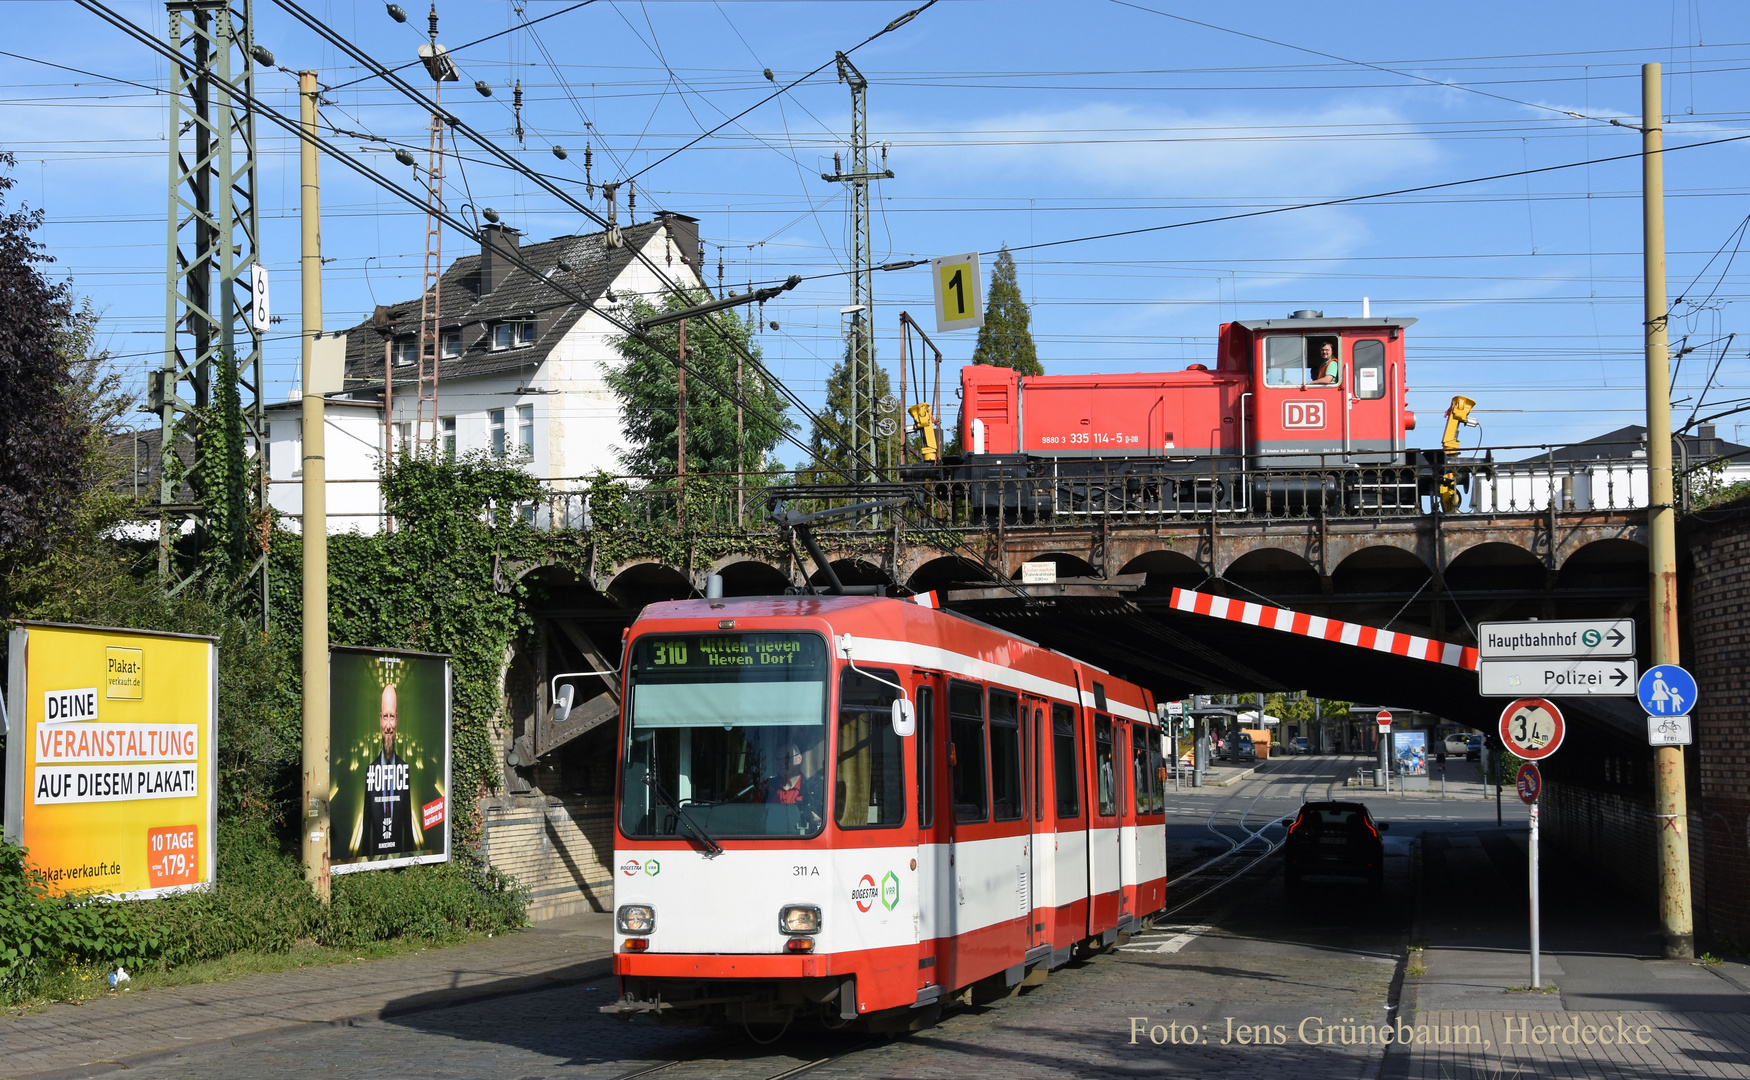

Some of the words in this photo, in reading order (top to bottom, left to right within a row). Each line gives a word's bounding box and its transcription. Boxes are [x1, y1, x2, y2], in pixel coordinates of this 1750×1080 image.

[948, 270, 965, 314] 1
[1288, 404, 1321, 425] DB
[1041, 436, 1059, 444] 9880
[1061, 436, 1066, 444] 3
[1070, 433, 1089, 444] 335
[1093, 433, 1123, 444] 114-5
[700, 637, 801, 653] Witten-Heven
[1488, 632, 1577, 650] Hauptbahnhof
[1584, 630, 1599, 646] S
[653, 641, 688, 665] 310
[709, 653, 754, 665] Heven
[760, 652, 794, 664] Dorf
[108, 658, 141, 674] Plakat-
[108, 677, 141, 687] verkauft.de
[1544, 670, 1602, 685] Polizei
[48, 693, 94, 719] DEINE
[40, 730, 194, 757] VERANSTALTUNG
[37, 774, 72, 798] AUF
[77, 772, 133, 797] DIESEM
[137, 769, 195, 794] PLAKAT!
[366, 764, 409, 791] #OFFICE
[151, 834, 163, 851] 10
[165, 832, 194, 850] TAGE
[792, 865, 808, 877] 311
[810, 865, 820, 876] A
[851, 887, 878, 900] BOGESTRA
[885, 886, 896, 896] VRR
